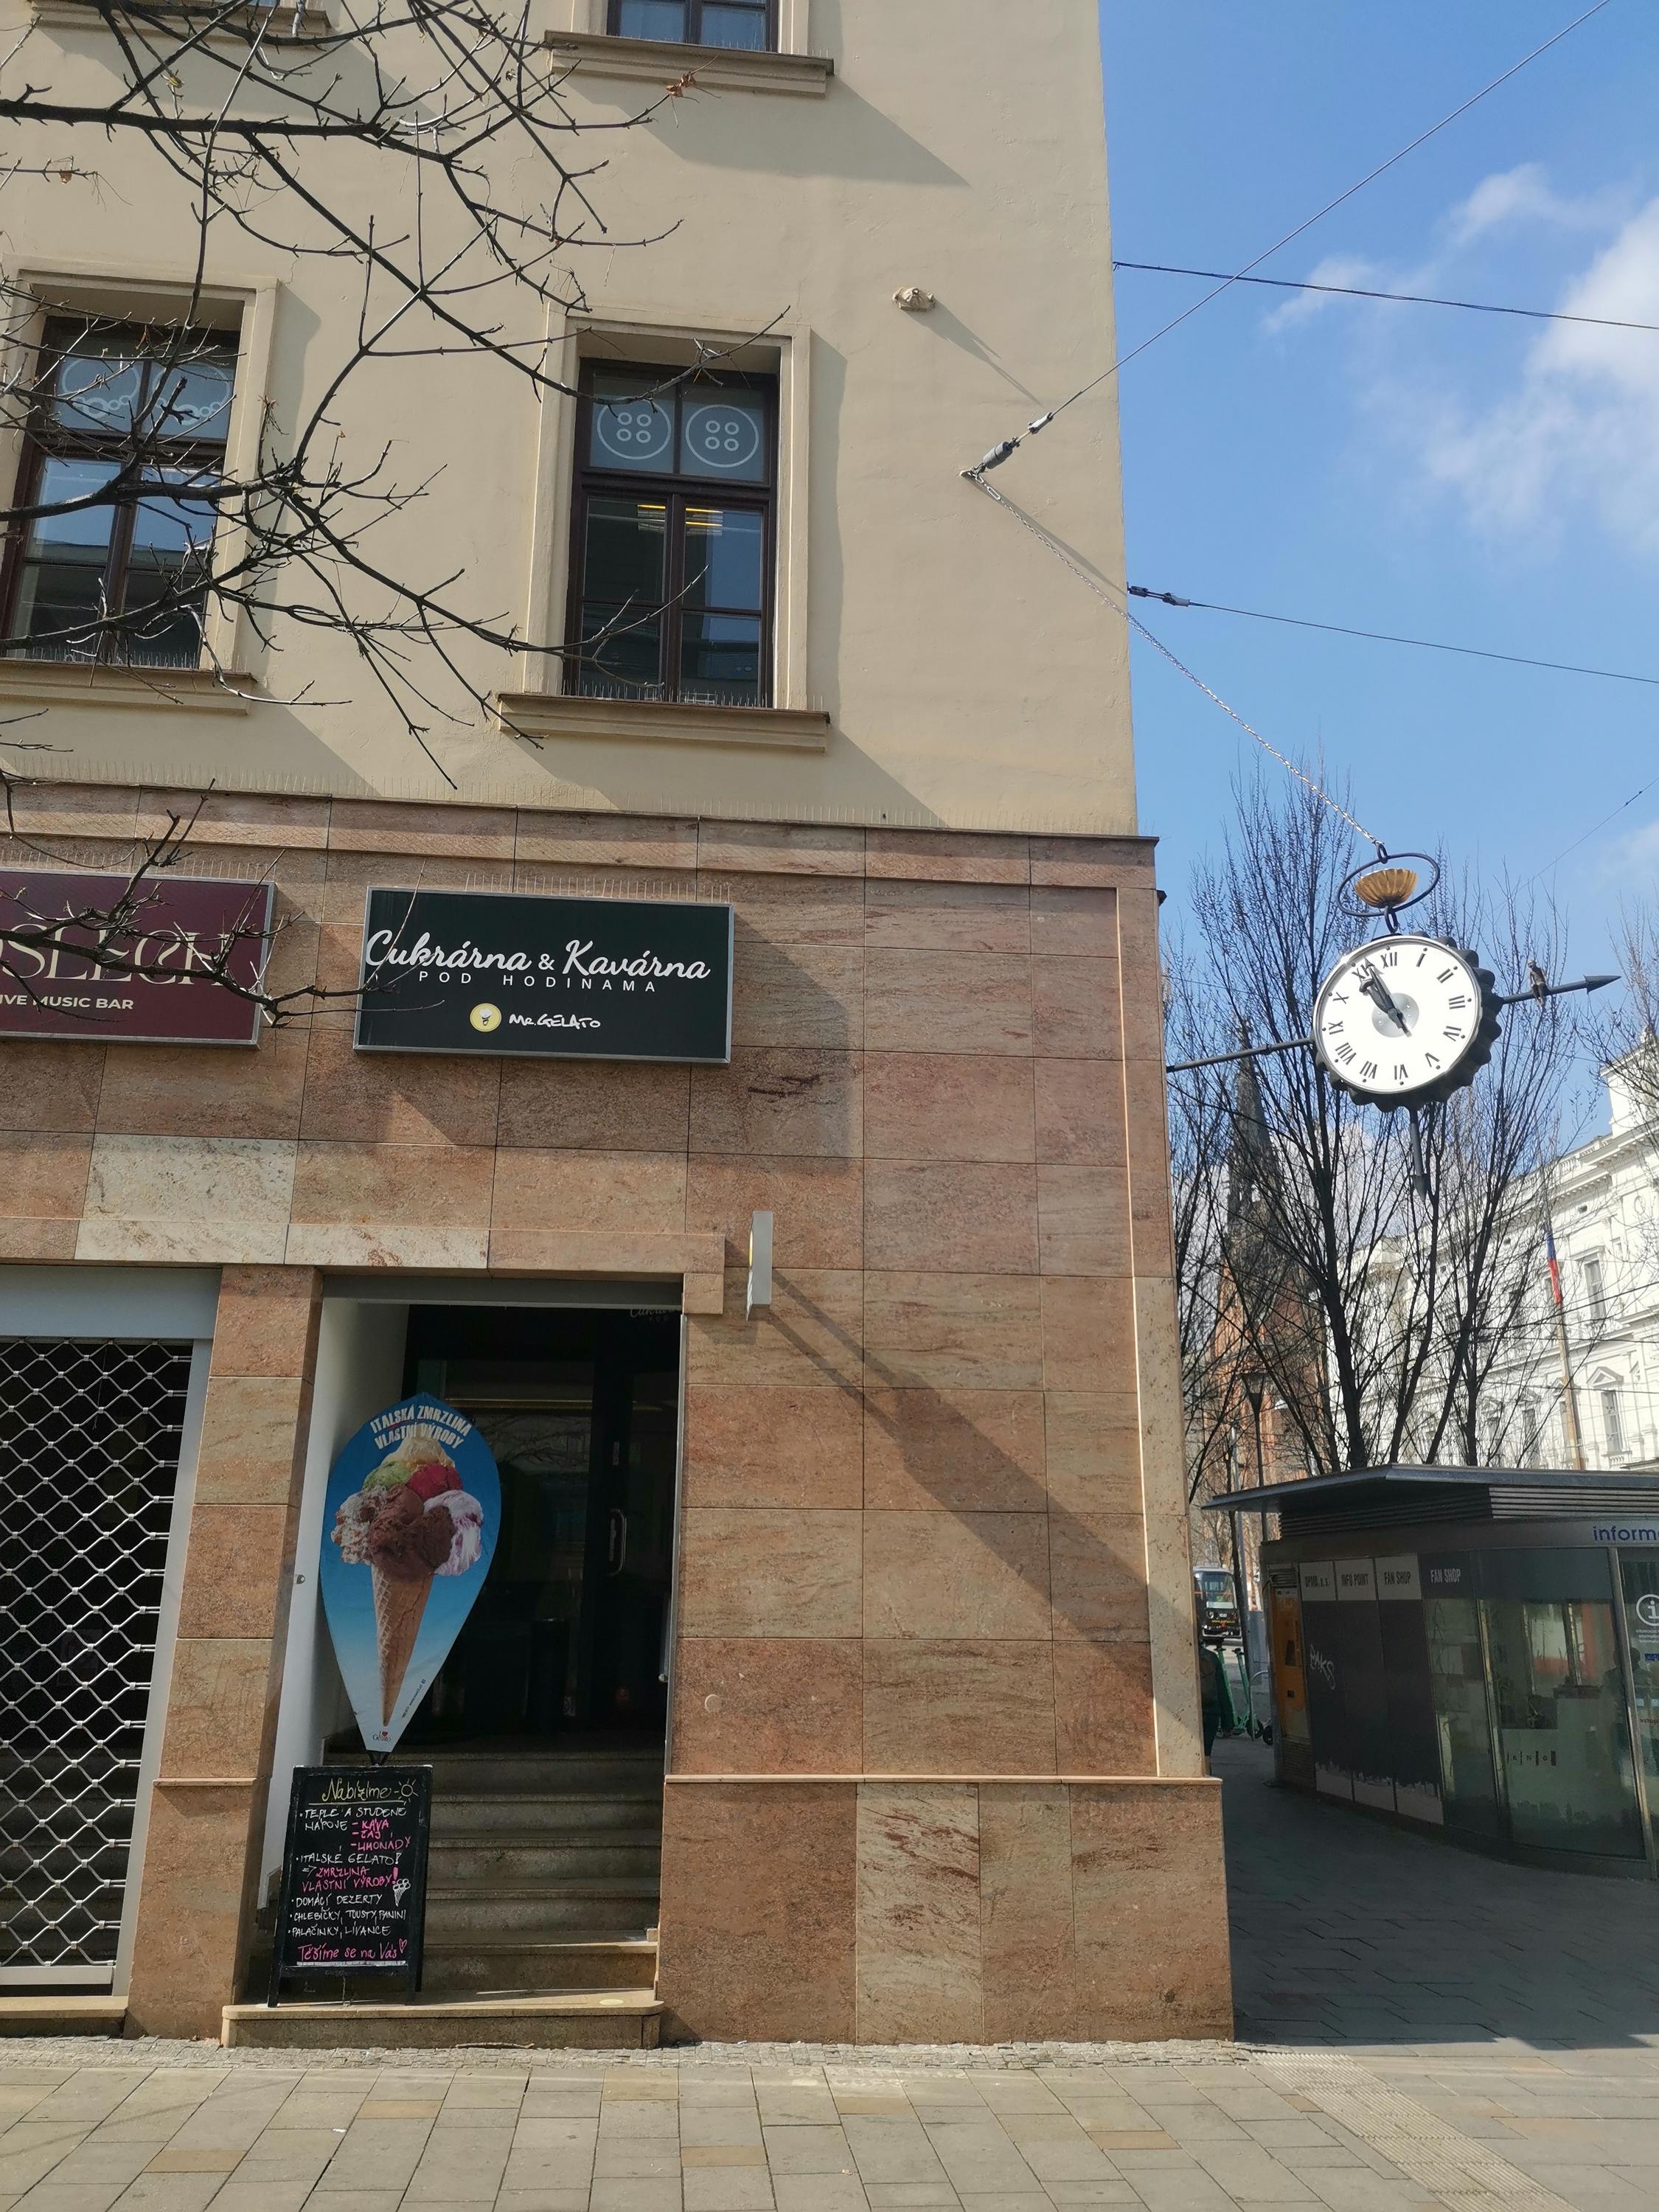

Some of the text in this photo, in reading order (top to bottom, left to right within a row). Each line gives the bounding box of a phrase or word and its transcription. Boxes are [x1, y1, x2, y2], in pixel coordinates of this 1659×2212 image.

[366, 929, 711, 979] Cukrárna & Kavárna
[1380, 952, 1397, 969] XII
[419, 971, 655, 992] POD HODINAMA
[1436, 968, 1454, 984] II
[32, 996, 92, 1008] MUSIC
[96, 998, 134, 1009] BAR
[1332, 991, 1349, 1004] X
[1449, 995, 1466, 1009] III
[1443, 1026, 1461, 1042] IV
[1335, 1042, 1357, 1065] VIII
[1425, 1052, 1439, 1068] V
[1359, 1061, 1377, 1079] VII
[1394, 1064, 1408, 1080] VI
[369, 1404, 472, 1437] ITALSKÁ ZMRZLINA
[374, 1422, 465, 1450] VLASTNÍ VÝROBY
[1593, 1526, 1659, 1541] inform
[1384, 1571, 1411, 1586] FAN SHOP
[1430, 1568, 1461, 1584] FAN SHOP
[344, 1807, 352, 1818] A
[300, 1846, 343, 1864] ITALSKÉ
[316, 1866, 370, 1878] ZMRZLINA
[302, 1875, 350, 1893] VLASTNÍ
[296, 1893, 383, 1908] DOMÁCÍ DEZERTY
[298, 1941, 398, 1961] Těšíme se na Vás
